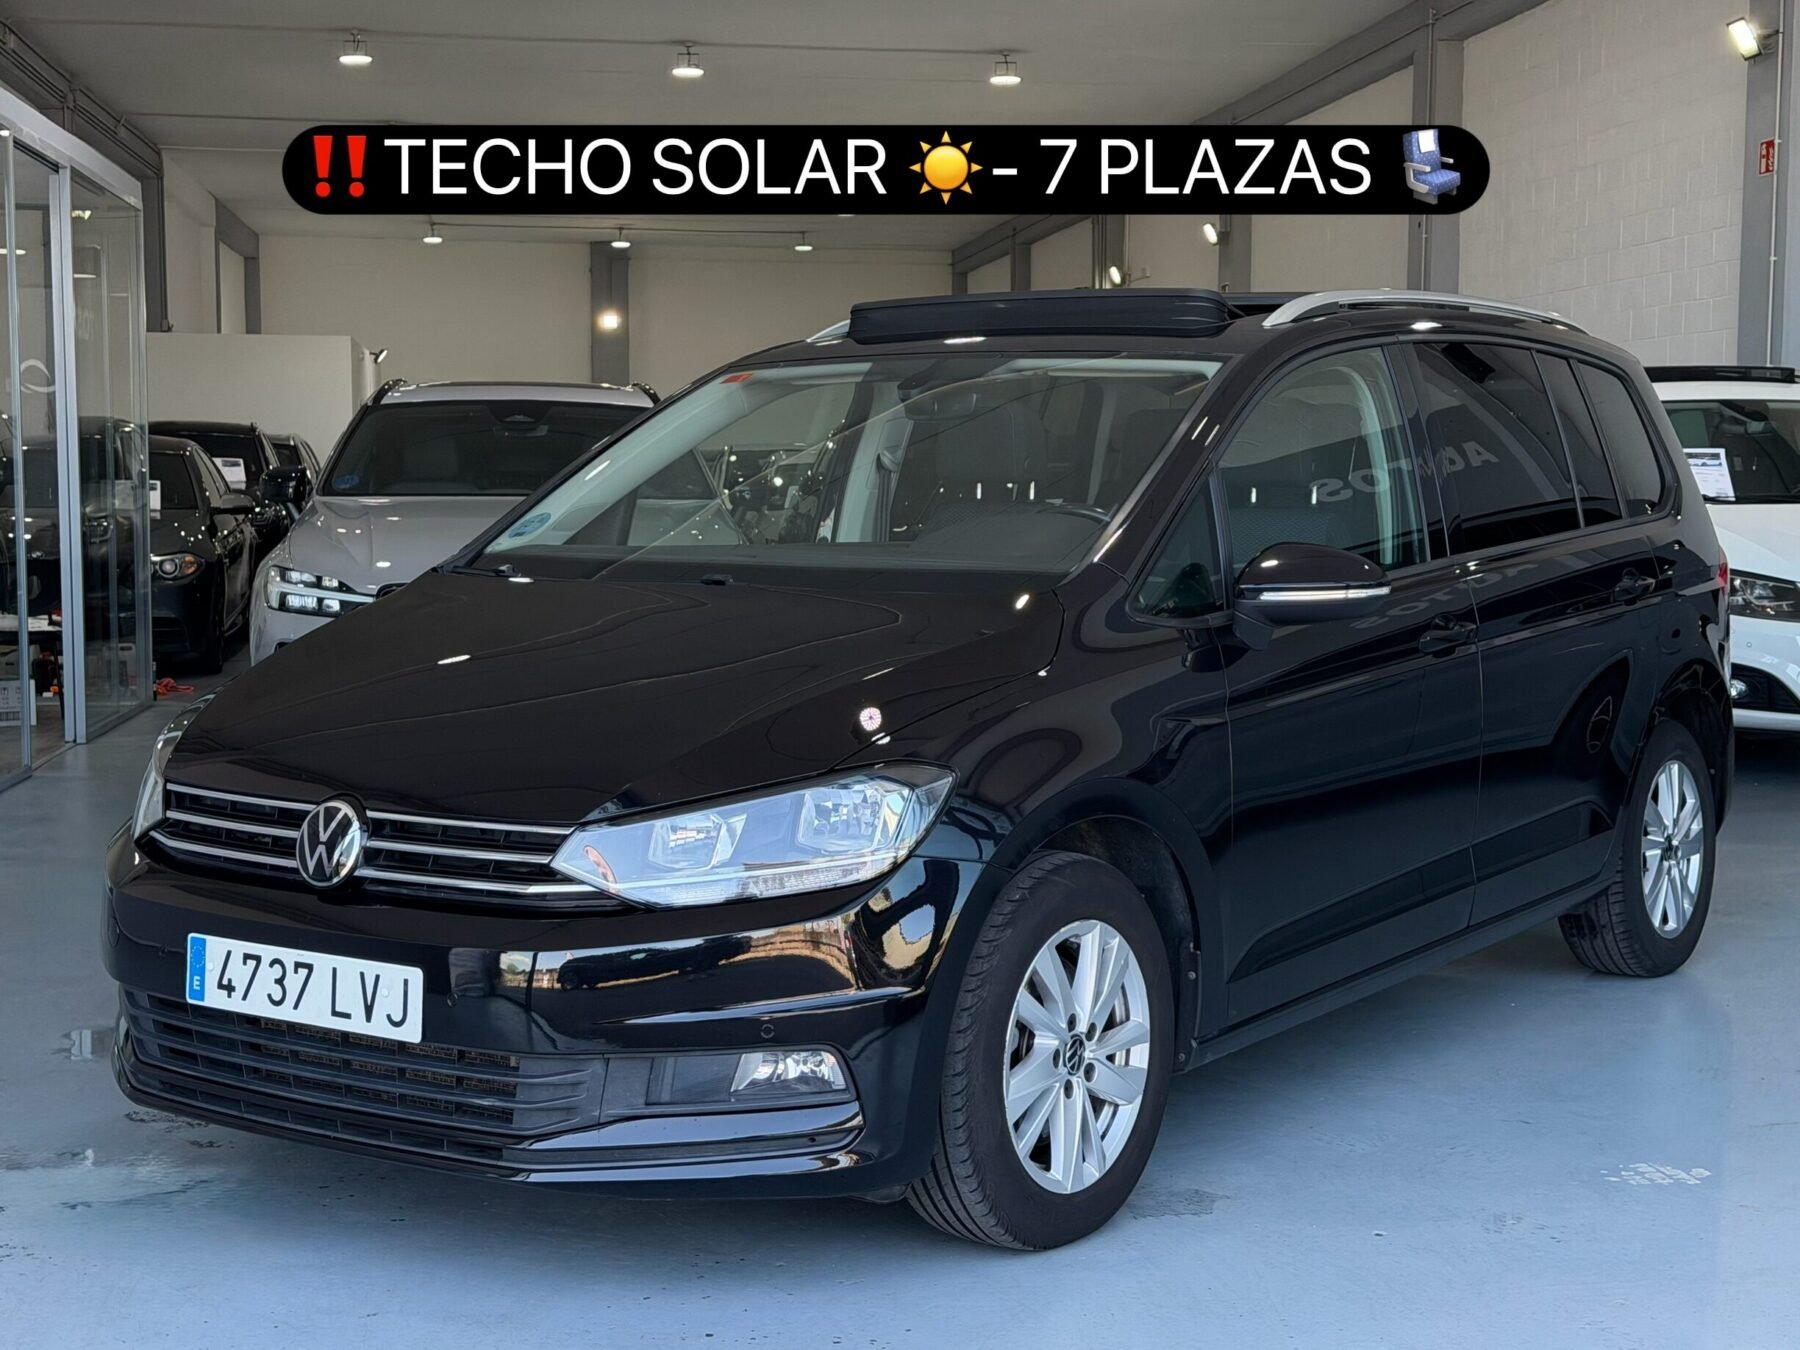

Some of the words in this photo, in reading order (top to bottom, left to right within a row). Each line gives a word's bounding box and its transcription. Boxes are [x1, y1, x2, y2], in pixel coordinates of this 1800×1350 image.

[193, 975, 201, 990] E
[216, 949, 315, 1011] 4737
[330, 966, 410, 1028] LVJ
